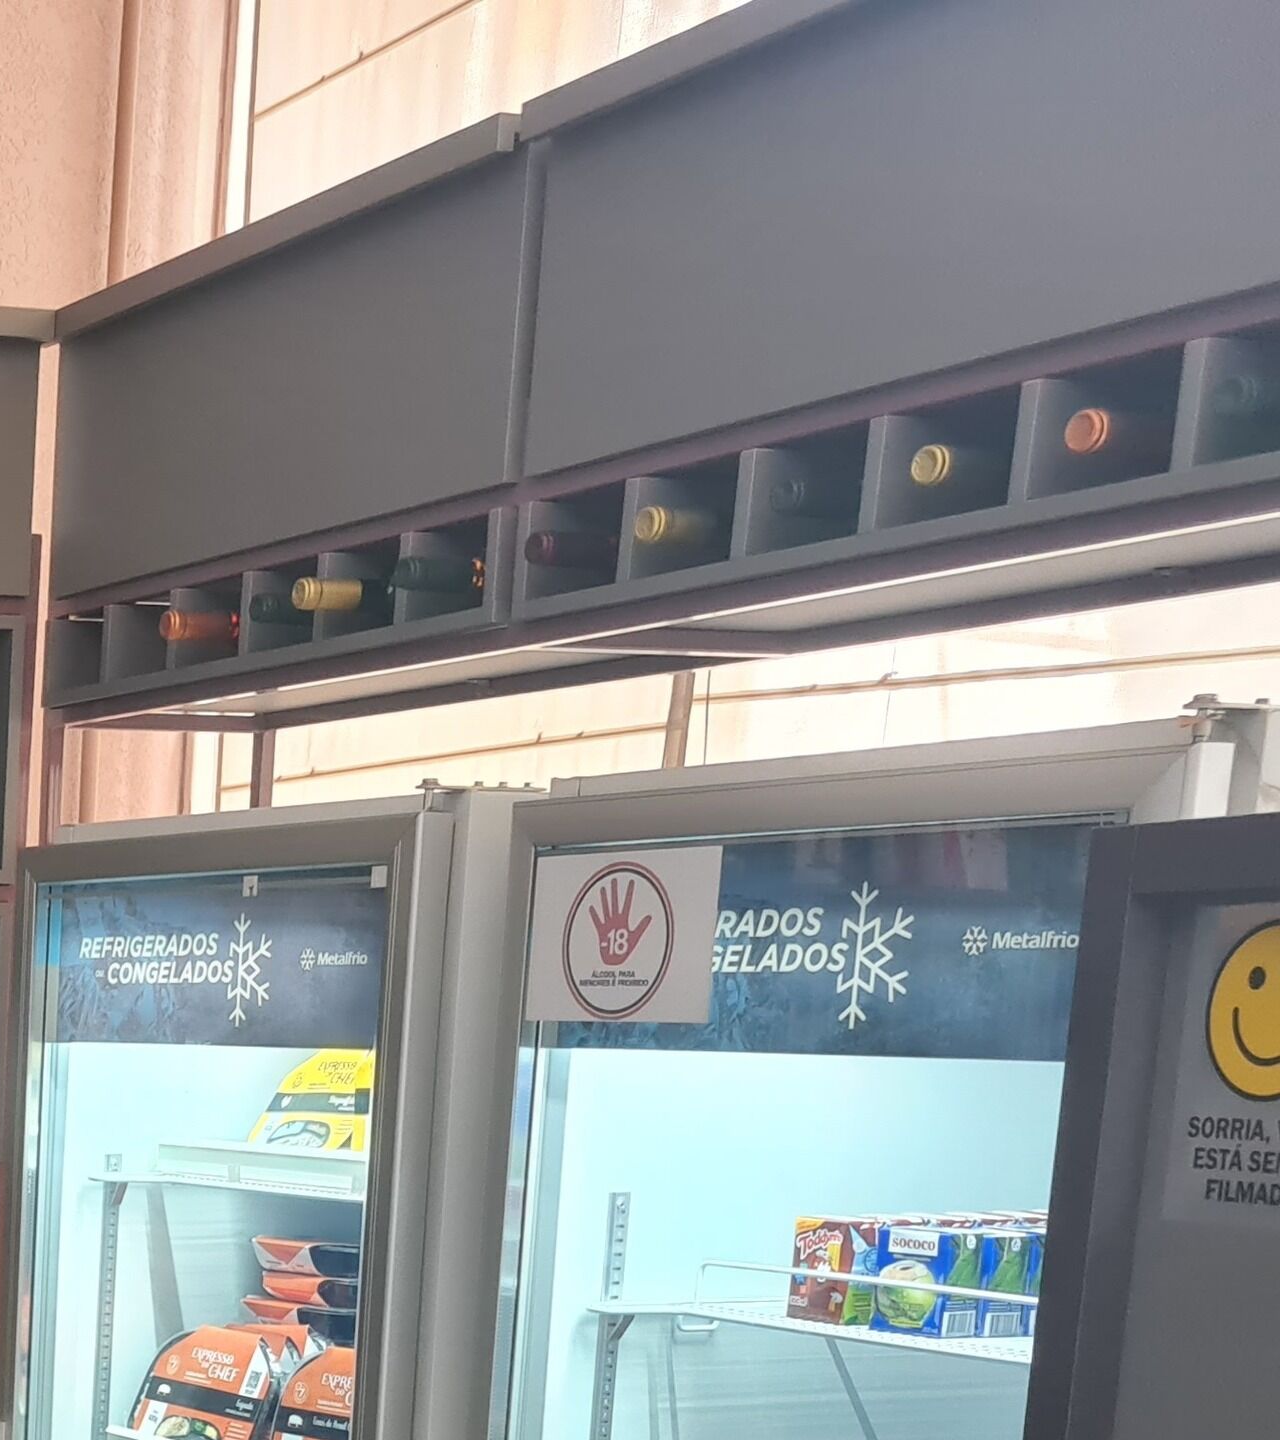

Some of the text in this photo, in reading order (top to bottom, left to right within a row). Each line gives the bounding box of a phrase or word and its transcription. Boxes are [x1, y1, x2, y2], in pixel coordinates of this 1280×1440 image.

[715, 907, 825, 938] RADOS
[79, 933, 219, 959] REFRIGERADOS
[992, 932, 1080, 951] Metalfrio
[317, 951, 368, 967] Metalfrio
[108, 960, 234, 985] CONGELADOS
[1188, 1116, 1270, 1143] SORRIA,
[1193, 1144, 1241, 1172] ESTÁ
[1205, 1179, 1280, 1206] FILMAD
[208, 1363, 240, 1382] CHEF
